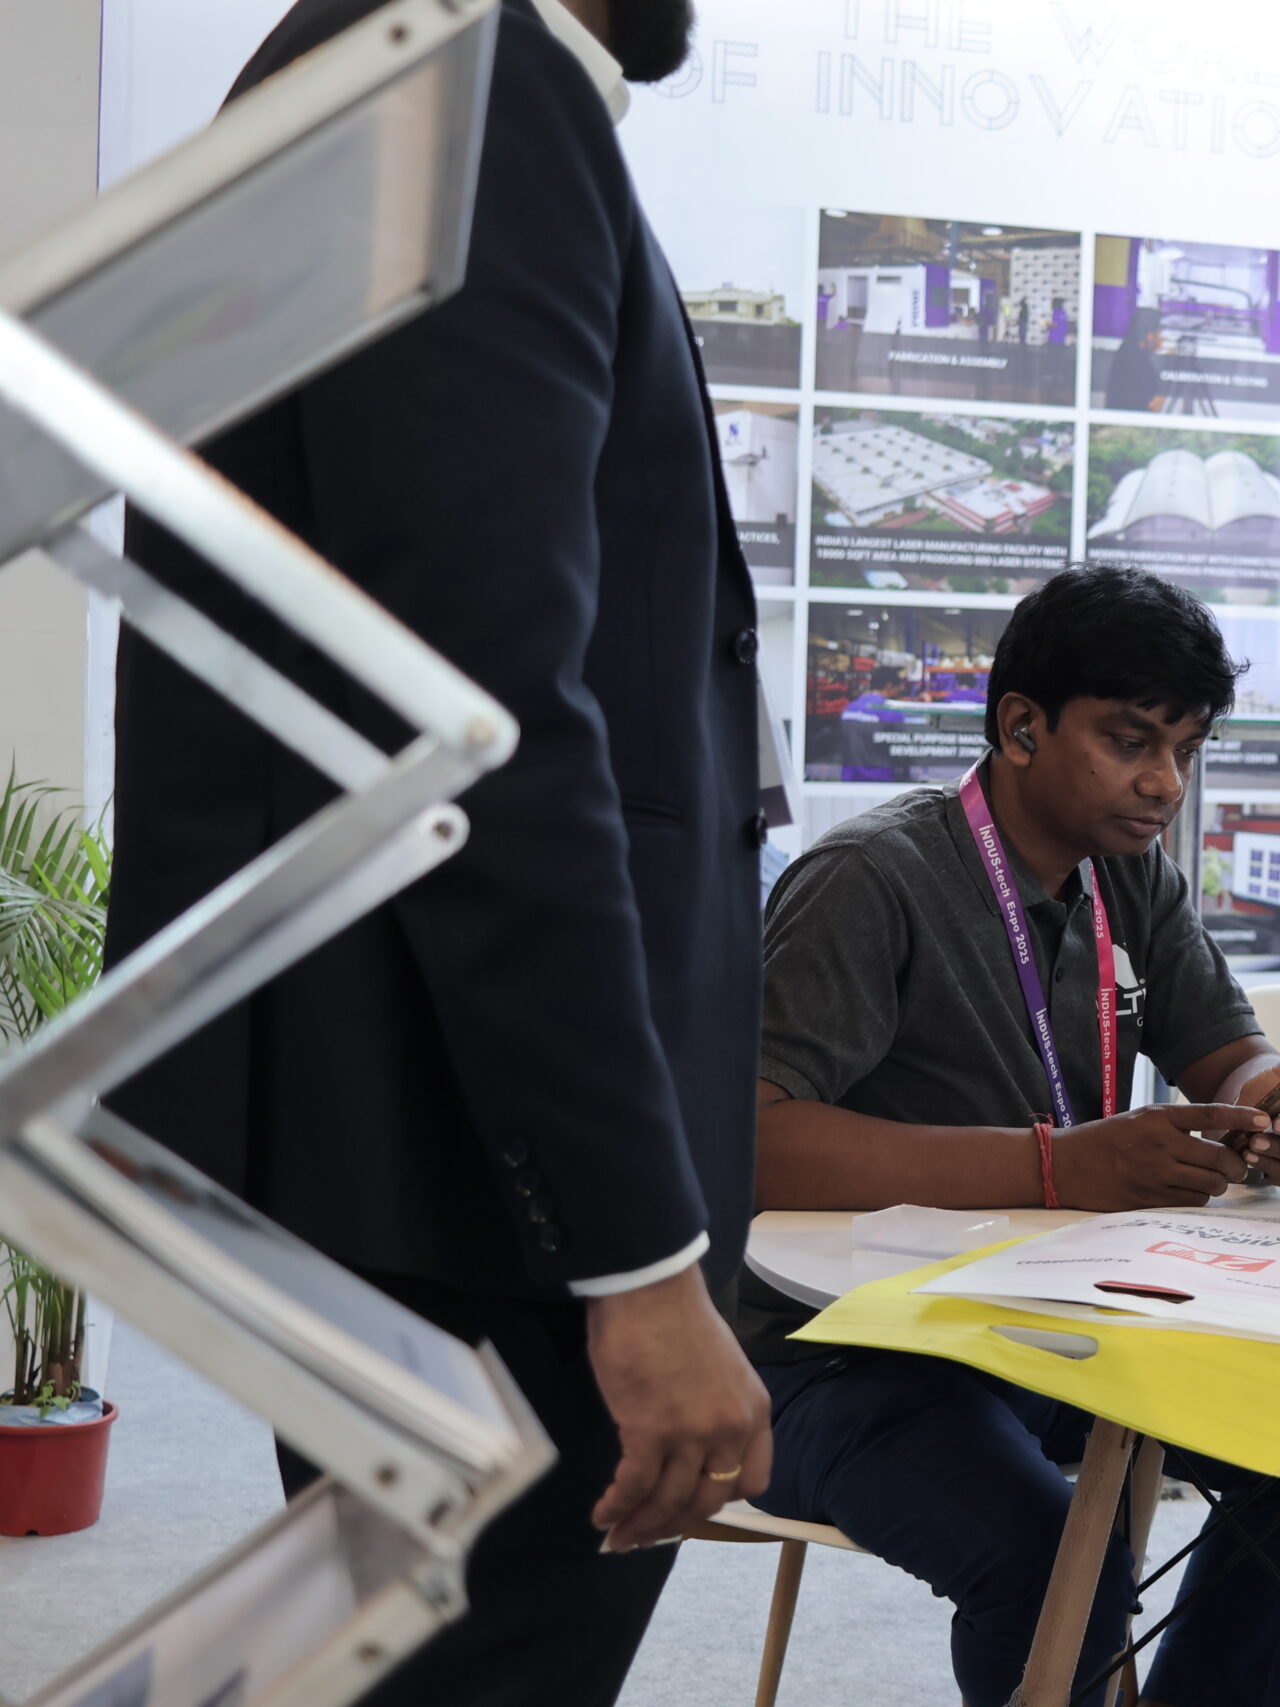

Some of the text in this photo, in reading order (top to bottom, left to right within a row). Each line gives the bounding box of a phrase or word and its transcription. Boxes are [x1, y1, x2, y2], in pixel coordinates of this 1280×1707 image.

[1006, 901, 1021, 933] Expo
[1015, 935, 1030, 965] 2025
[1095, 908, 1105, 939] 2025
[1104, 1064, 1112, 1096] Expo
[1054, 1082, 1067, 1112] Expo
